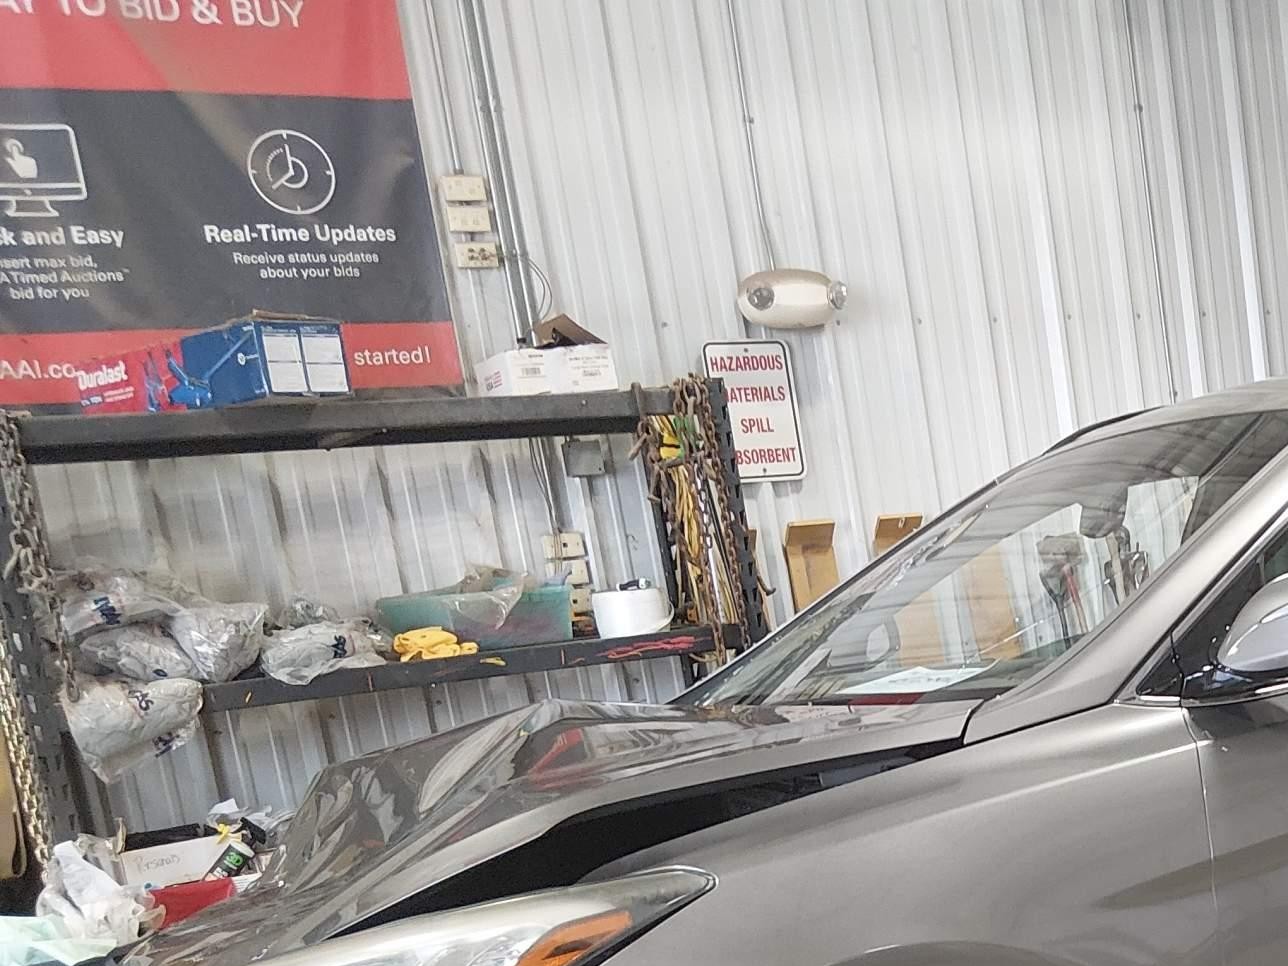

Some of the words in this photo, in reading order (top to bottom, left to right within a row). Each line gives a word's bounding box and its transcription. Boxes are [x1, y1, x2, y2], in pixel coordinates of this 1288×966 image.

[119, 0, 180, 21] BID
[192, 0, 223, 25] &
[230, 0, 303, 28] BUY
[22, 227, 66, 246] and
[69, 225, 124, 249] Easy
[203, 224, 310, 243] Real-Time
[313, 223, 397, 246] Updates
[34, 257, 66, 268] max
[232, 252, 285, 265] Receive
[288, 252, 327, 264] status
[330, 252, 379, 266] updates
[260, 266, 299, 279] about
[300, 267, 331, 280] your
[333, 265, 361, 278] bids
[9, 287, 35, 300] bid
[36, 286, 59, 299] for
[61, 286, 90, 301] you
[354, 345, 431, 366] started!
[709, 354, 783, 373] HAZARDOUS
[0, 359, 75, 379] AAI.co
[78, 360, 128, 391] Duralast
[741, 417, 775, 434] SPILL
[735, 447, 797, 465] BSORBENT
